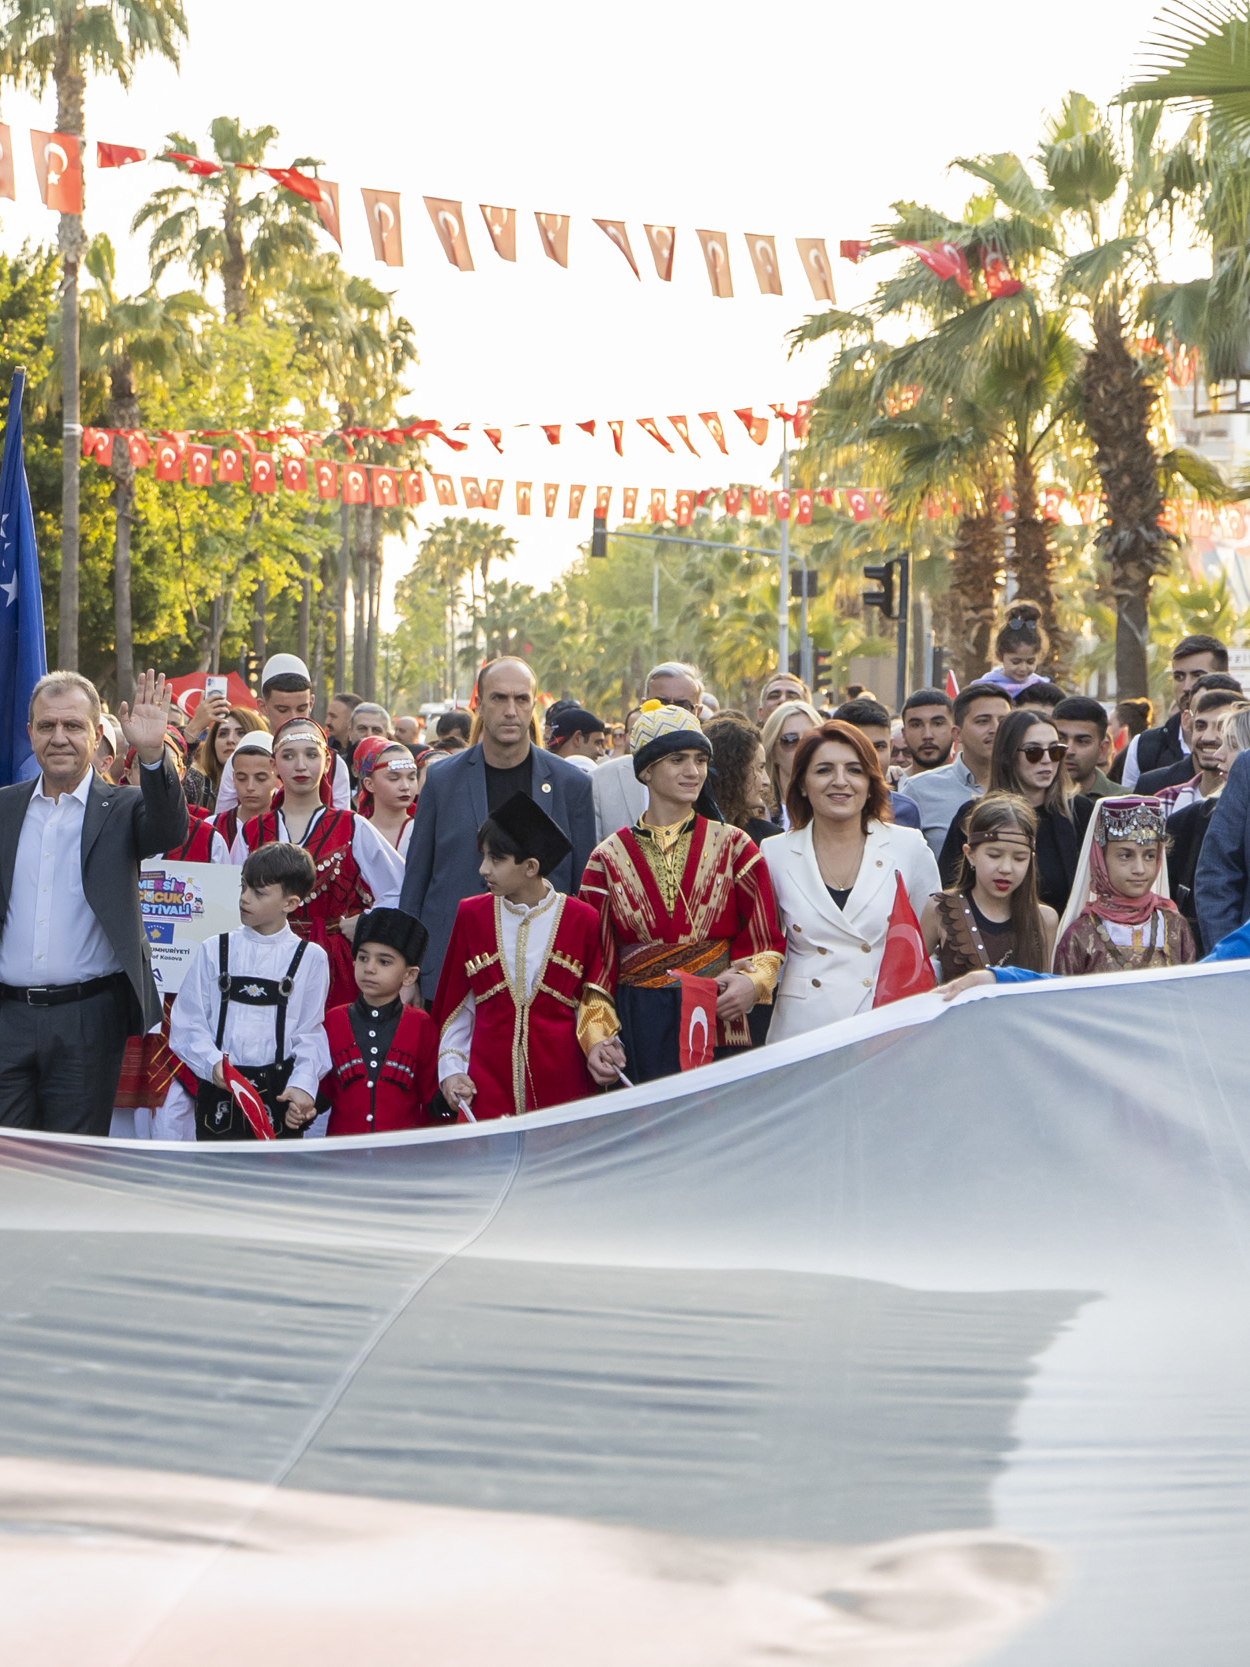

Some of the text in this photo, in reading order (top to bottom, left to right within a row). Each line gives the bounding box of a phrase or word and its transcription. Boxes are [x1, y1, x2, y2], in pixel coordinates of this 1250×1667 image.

[138, 878, 185, 893] MERSİN
[141, 903, 190, 915] STİVALİ
[151, 946, 190, 955] UMHURİYETİ
